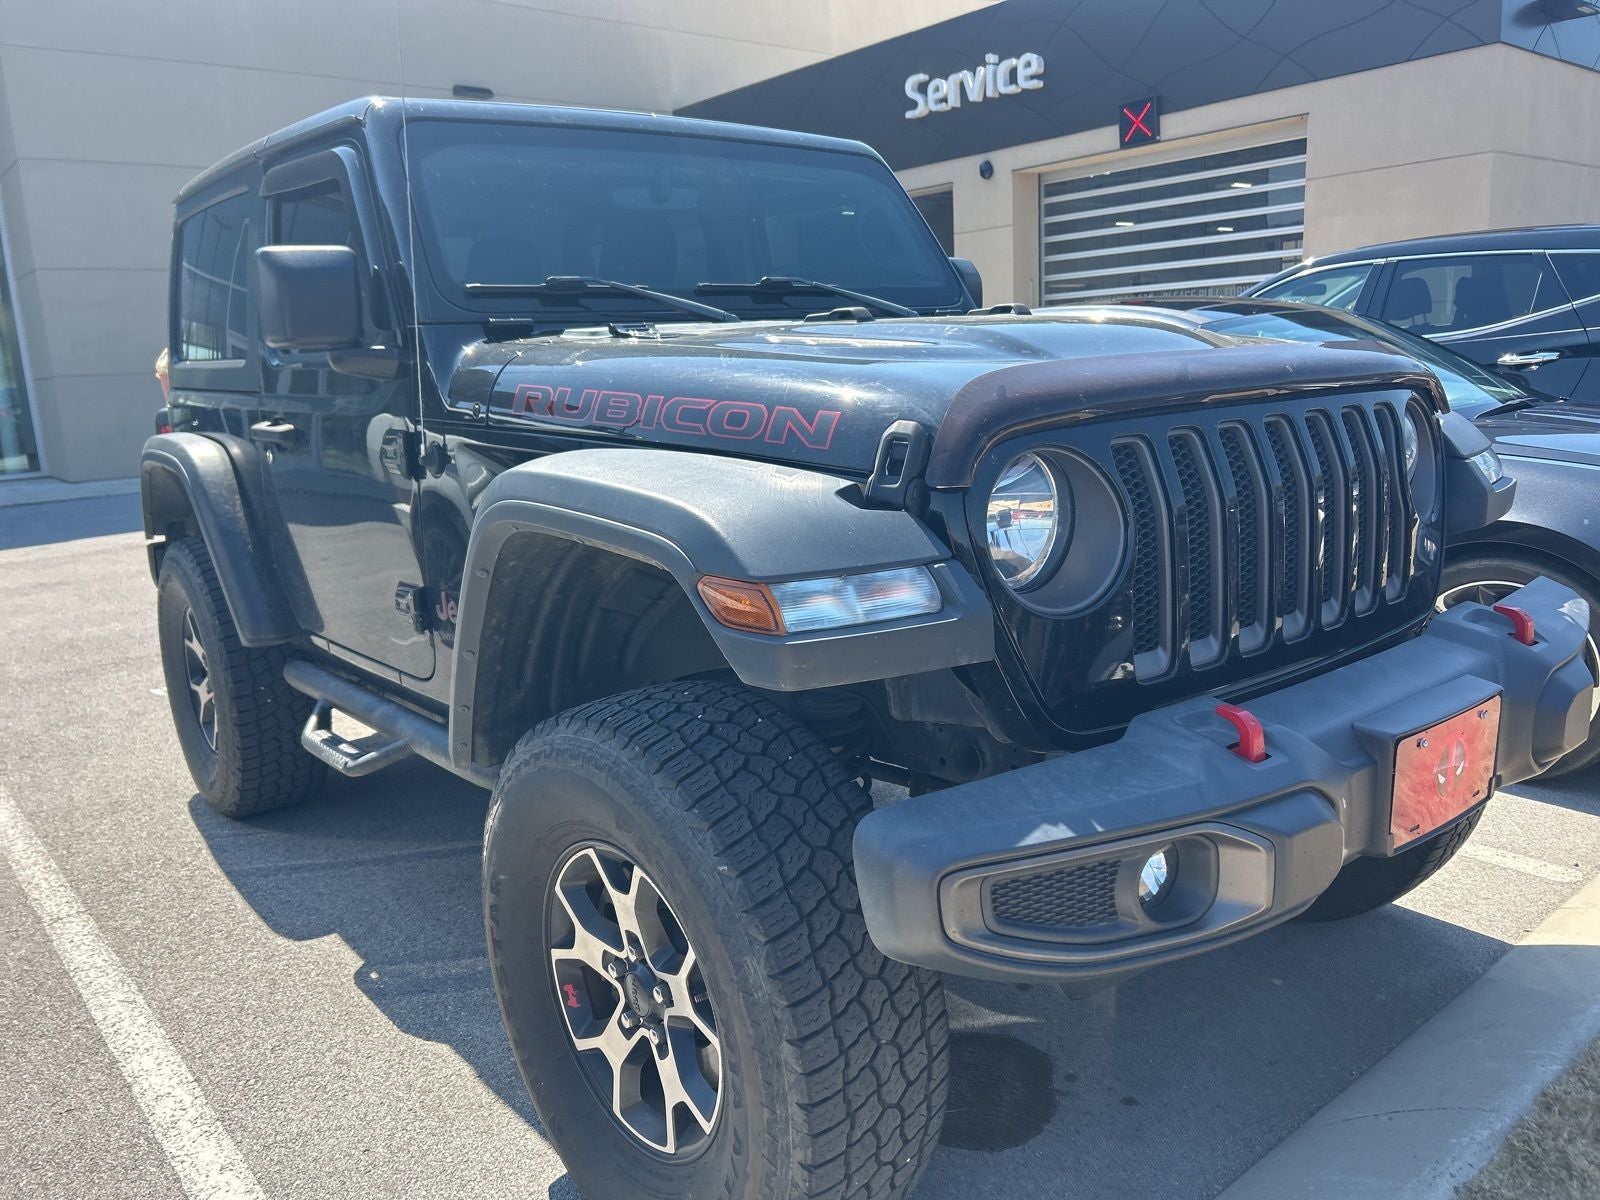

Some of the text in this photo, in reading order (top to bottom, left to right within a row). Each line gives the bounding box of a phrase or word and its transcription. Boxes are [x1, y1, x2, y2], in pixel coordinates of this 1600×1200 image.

[905, 53, 1044, 119] Service
[511, 384, 842, 450] RUBICON
[435, 591, 459, 624] Je
